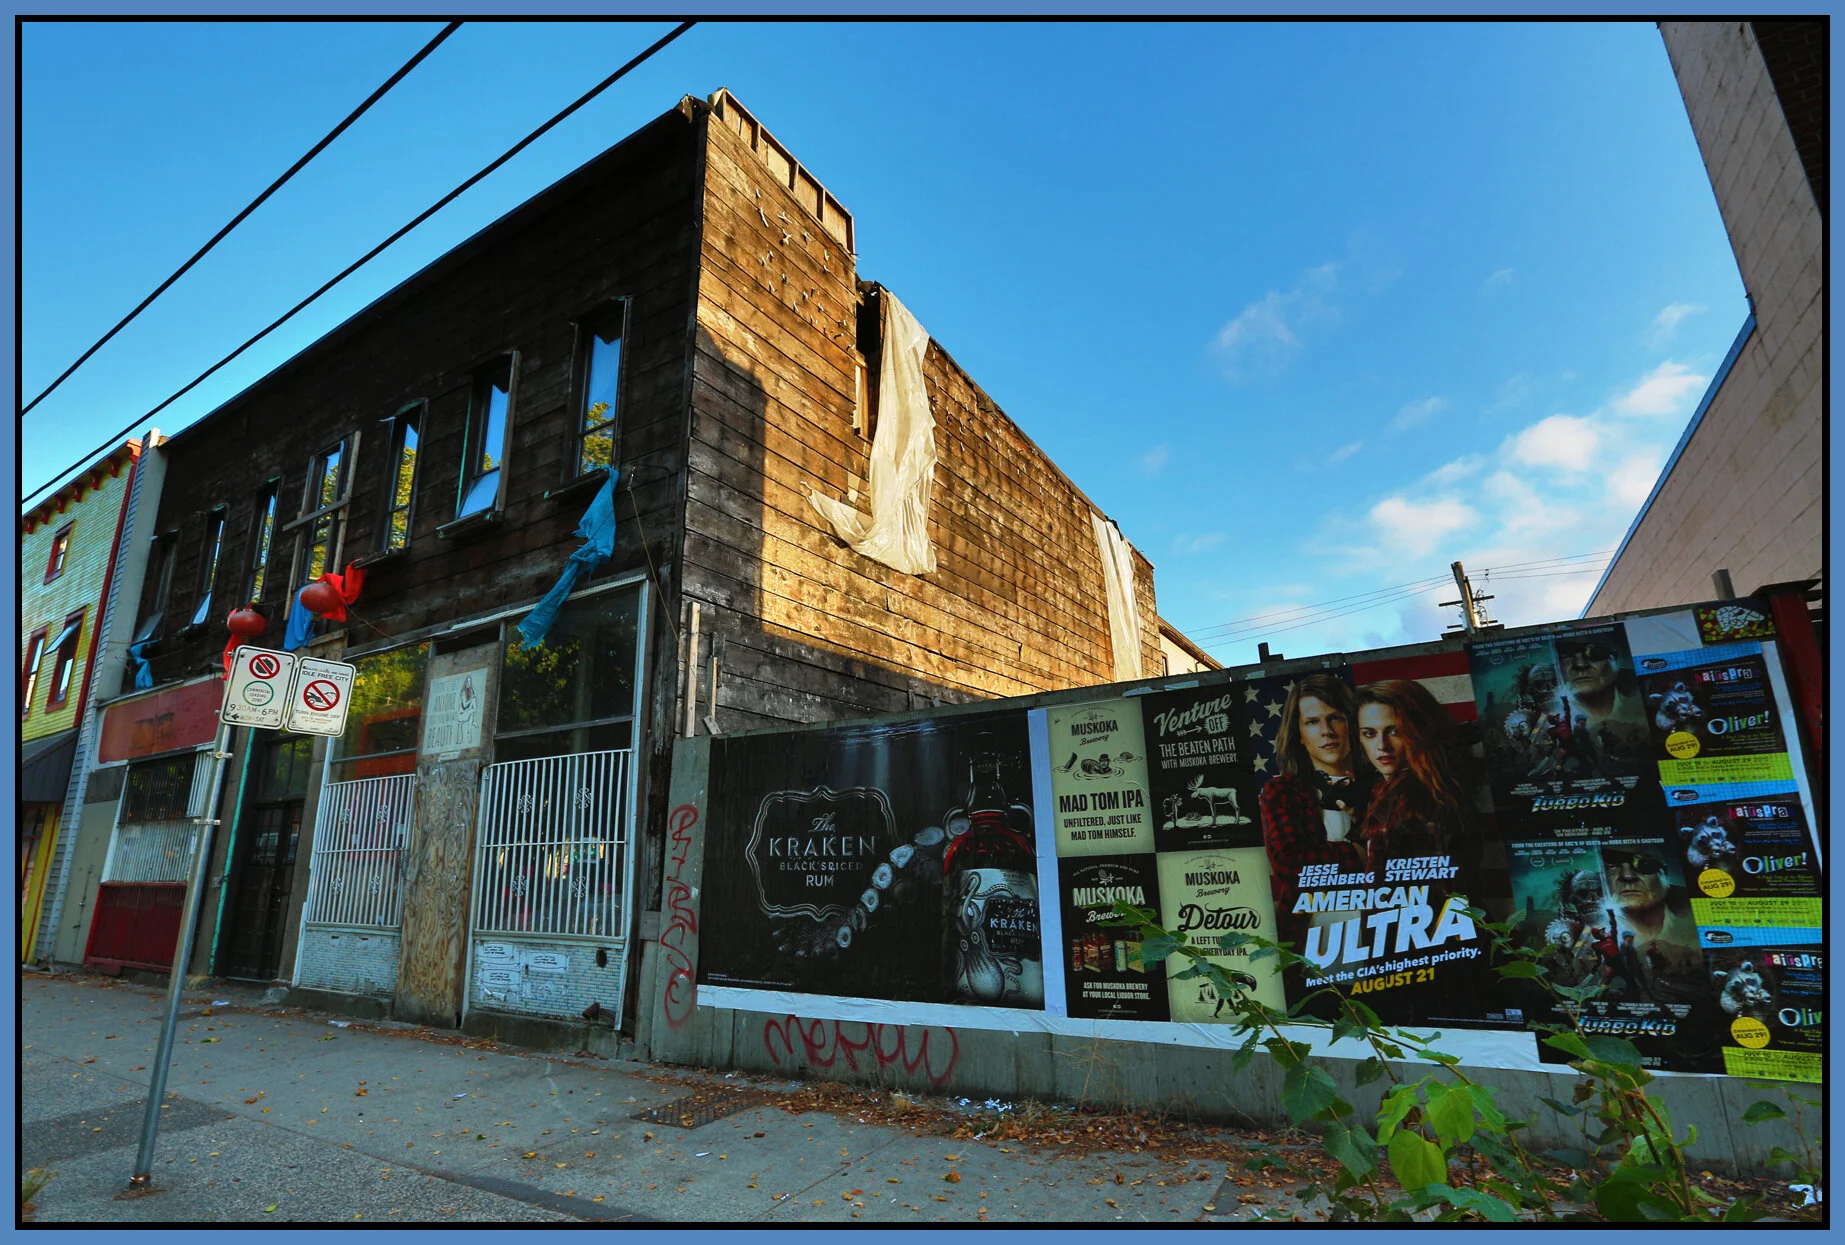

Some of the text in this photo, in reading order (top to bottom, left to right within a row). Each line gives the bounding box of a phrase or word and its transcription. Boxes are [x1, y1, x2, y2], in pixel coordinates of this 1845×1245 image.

[1154, 694, 1232, 736] Venture
[1208, 716, 1226, 731] OFF
[1708, 710, 1771, 735] Oliver!
[1071, 720, 1118, 736] MUSKOKA
[1080, 734, 1110, 746] Brewery
[1159, 737, 1236, 758] THE BEATEN PATH
[1161, 759, 1177, 769] WITH
[1179, 756, 1208, 768] MUSKOKA
[1059, 789, 1144, 813] MAD TOM IPA
[808, 811, 836, 832] The
[1107, 815, 1124, 826] JUST
[1126, 814, 1142, 824] LIKE
[1071, 828, 1136, 840] MAD TOM HIMSELF.
[769, 835, 876, 856] KRAKEN
[780, 862, 863, 871] BLACK SPICED
[1298, 856, 1450, 876] JESSE KRISTEN
[1742, 852, 1808, 874] Oliver!
[806, 874, 834, 887] RUM
[1185, 870, 1240, 886] MUSKOKA
[1298, 866, 1459, 888] EISENBERG STEWART
[1072, 886, 1145, 906] MUSKOKA
[1196, 886, 1230, 898] Brewery
[1292, 885, 1430, 914] AMERICAN
[990, 918, 1039, 932] KRAKEN
[1178, 902, 1261, 932] Detour
[1196, 936, 1210, 944] LEFT
[1305, 897, 1477, 970] ULTRA
[1336, 971, 1354, 983] the
[1356, 965, 1385, 978] CIA's
[1385, 956, 1429, 972] highest
[1432, 948, 1481, 966] priority.
[1351, 967, 1435, 995] AUGUST 21
